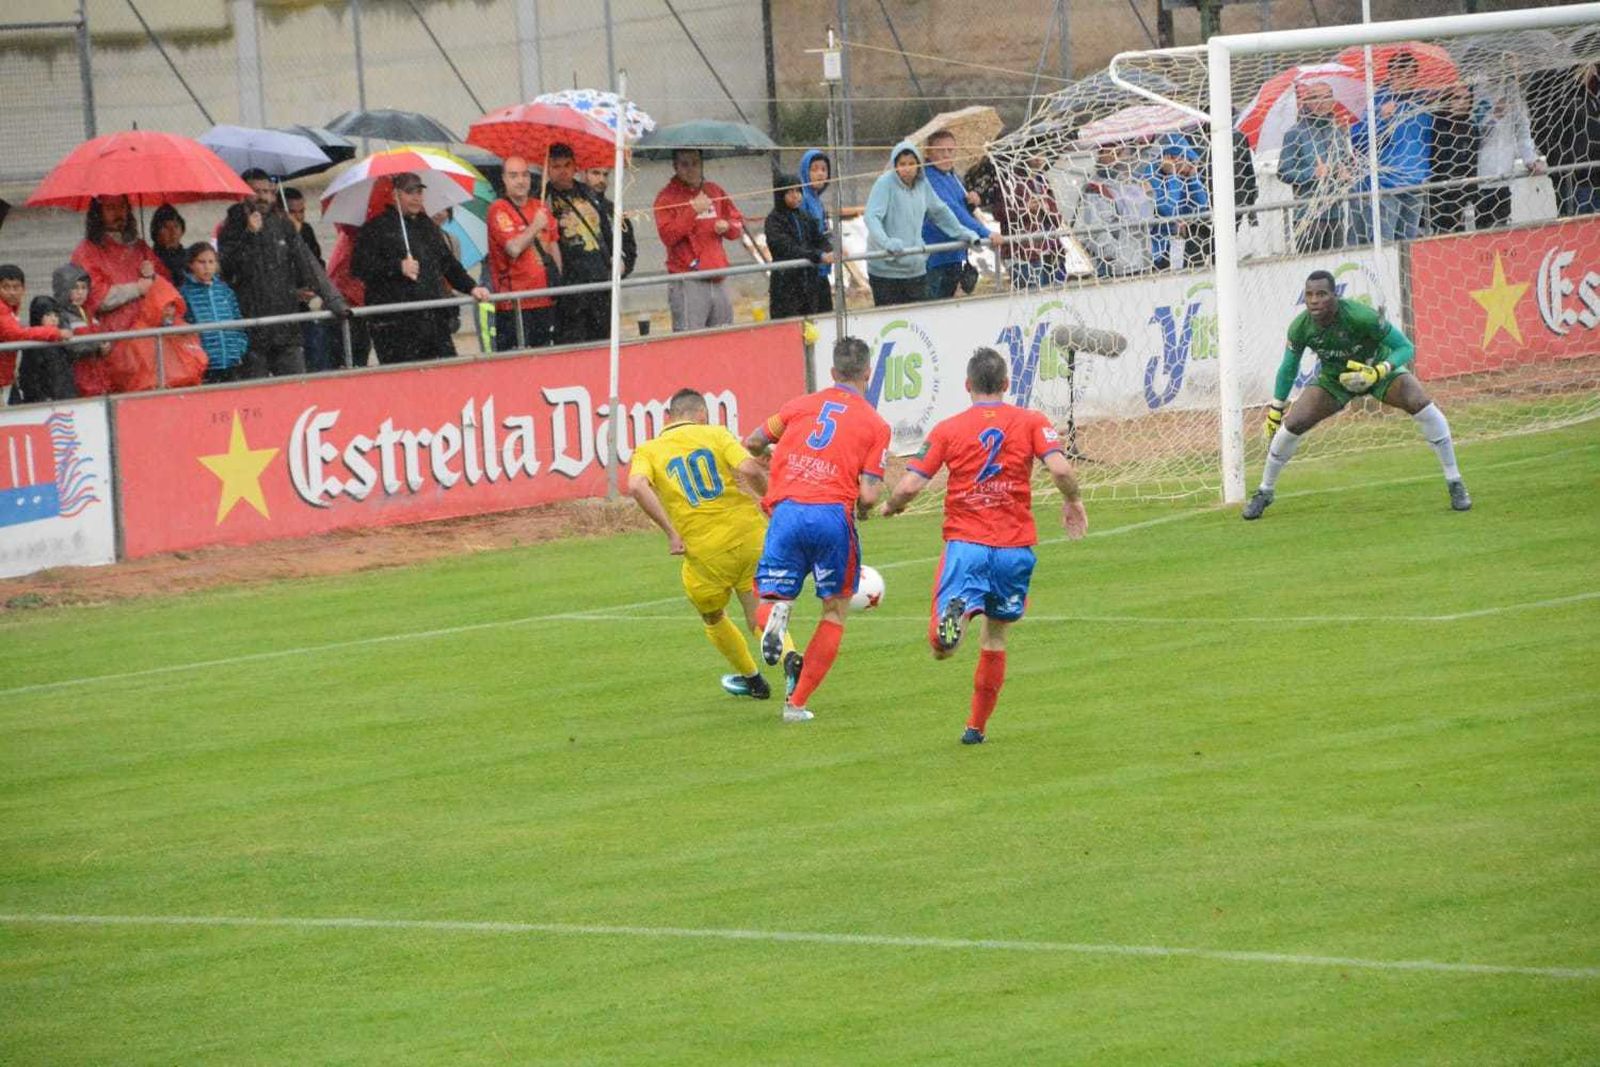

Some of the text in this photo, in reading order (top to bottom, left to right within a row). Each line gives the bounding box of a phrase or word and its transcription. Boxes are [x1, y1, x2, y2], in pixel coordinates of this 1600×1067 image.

[288, 395, 541, 508] Estrella
[806, 401, 846, 450] 5
[666, 448, 724, 508] 10
[975, 428, 1007, 483] 2
